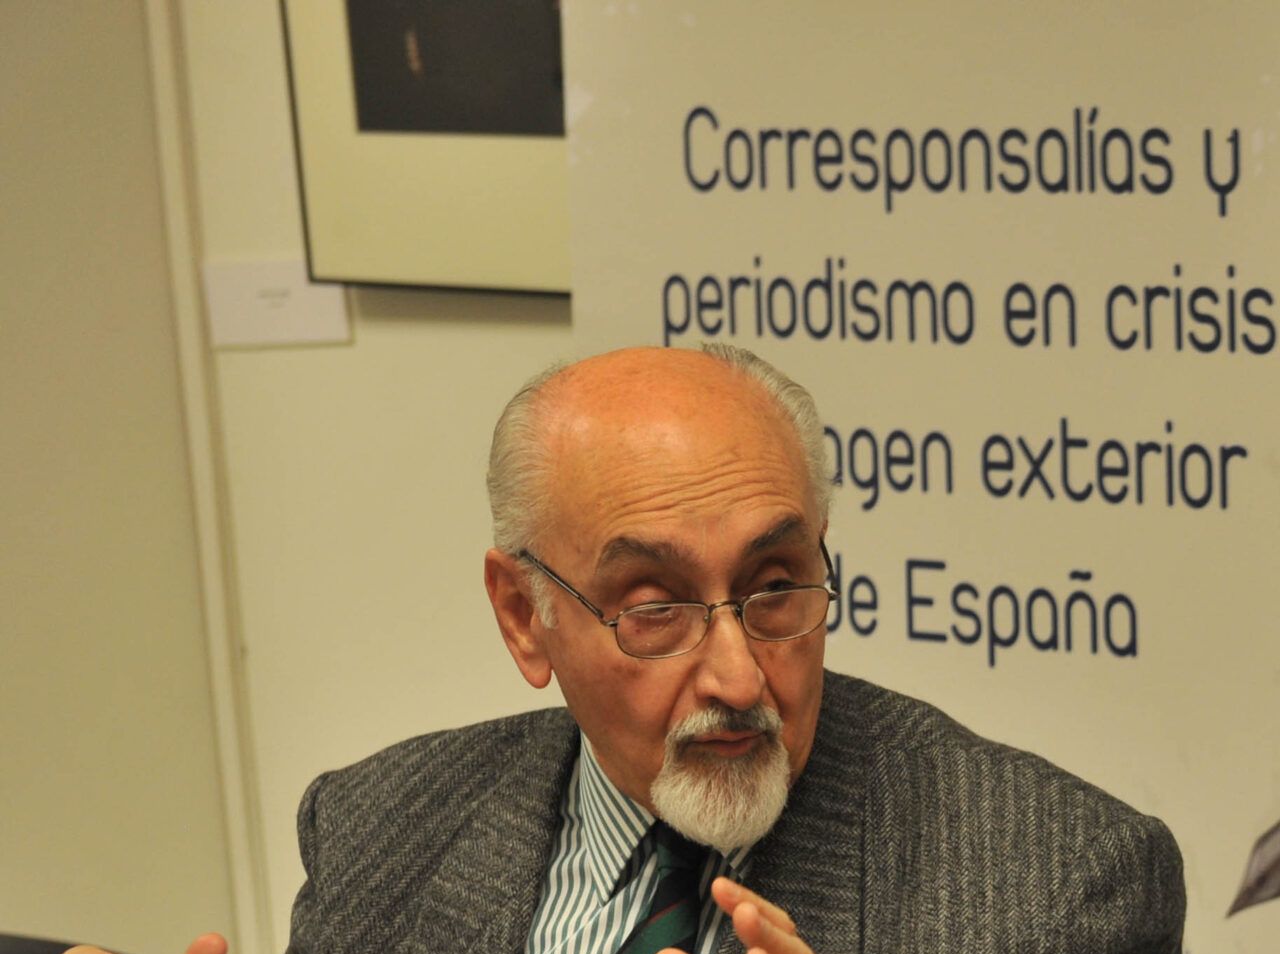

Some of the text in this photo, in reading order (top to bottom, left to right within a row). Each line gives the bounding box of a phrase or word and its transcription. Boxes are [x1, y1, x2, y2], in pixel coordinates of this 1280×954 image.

[683, 106, 1241, 218] Corresponsalías y
[662, 256, 1277, 355] periodismo en crisis
[981, 417, 1248, 510] exterior
[826, 552, 1138, 668] de España
